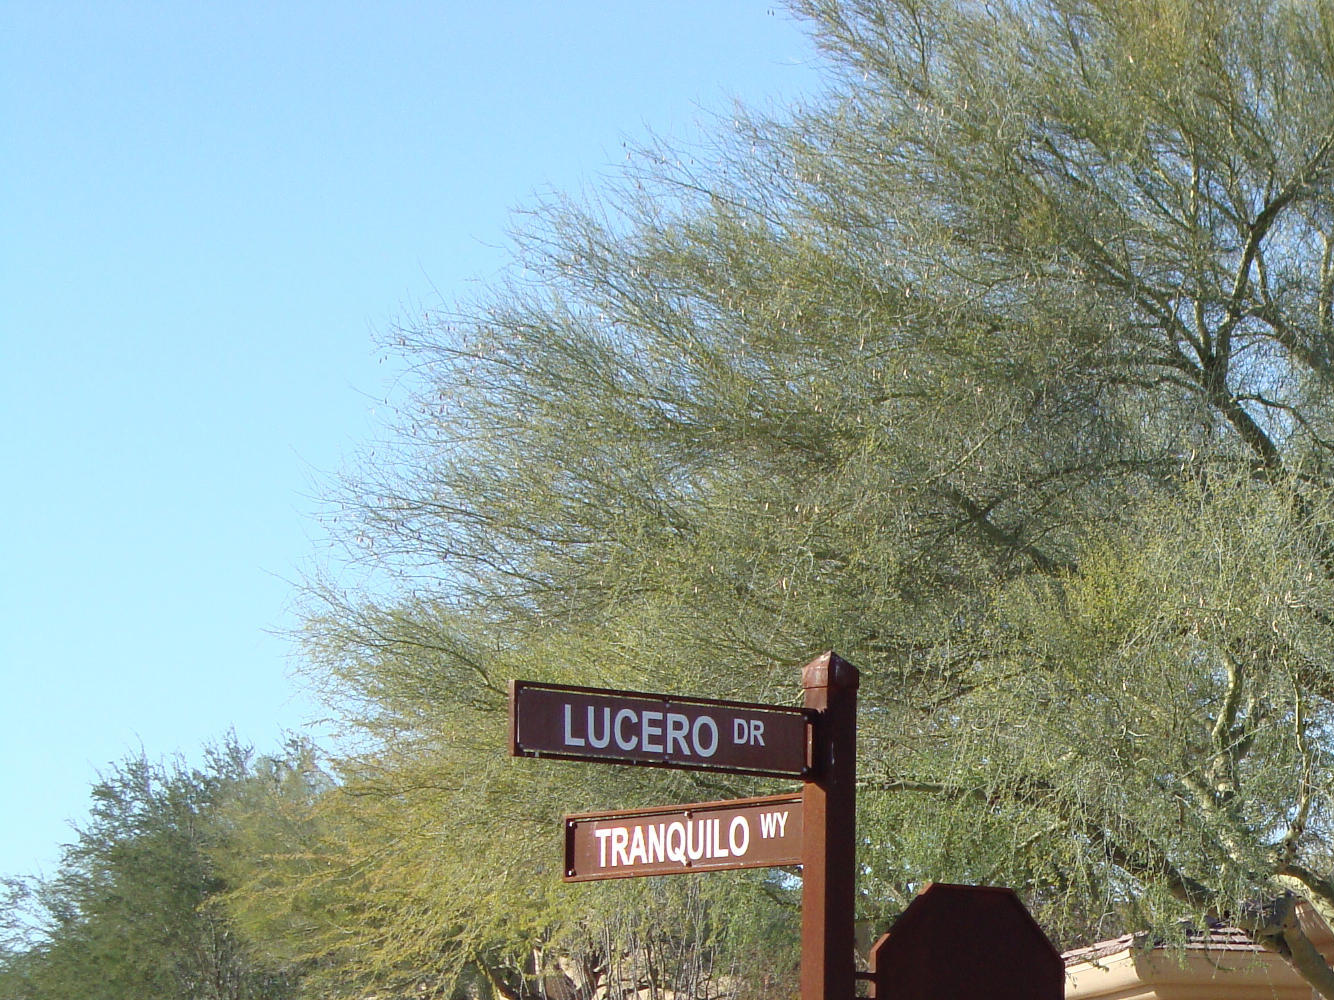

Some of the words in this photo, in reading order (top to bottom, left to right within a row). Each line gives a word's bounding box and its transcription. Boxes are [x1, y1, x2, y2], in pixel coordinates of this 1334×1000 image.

[564, 703, 719, 757] LUCERO
[733, 718, 766, 746] DR
[595, 815, 750, 867] TRANQUILO
[760, 811, 789, 839] WY
